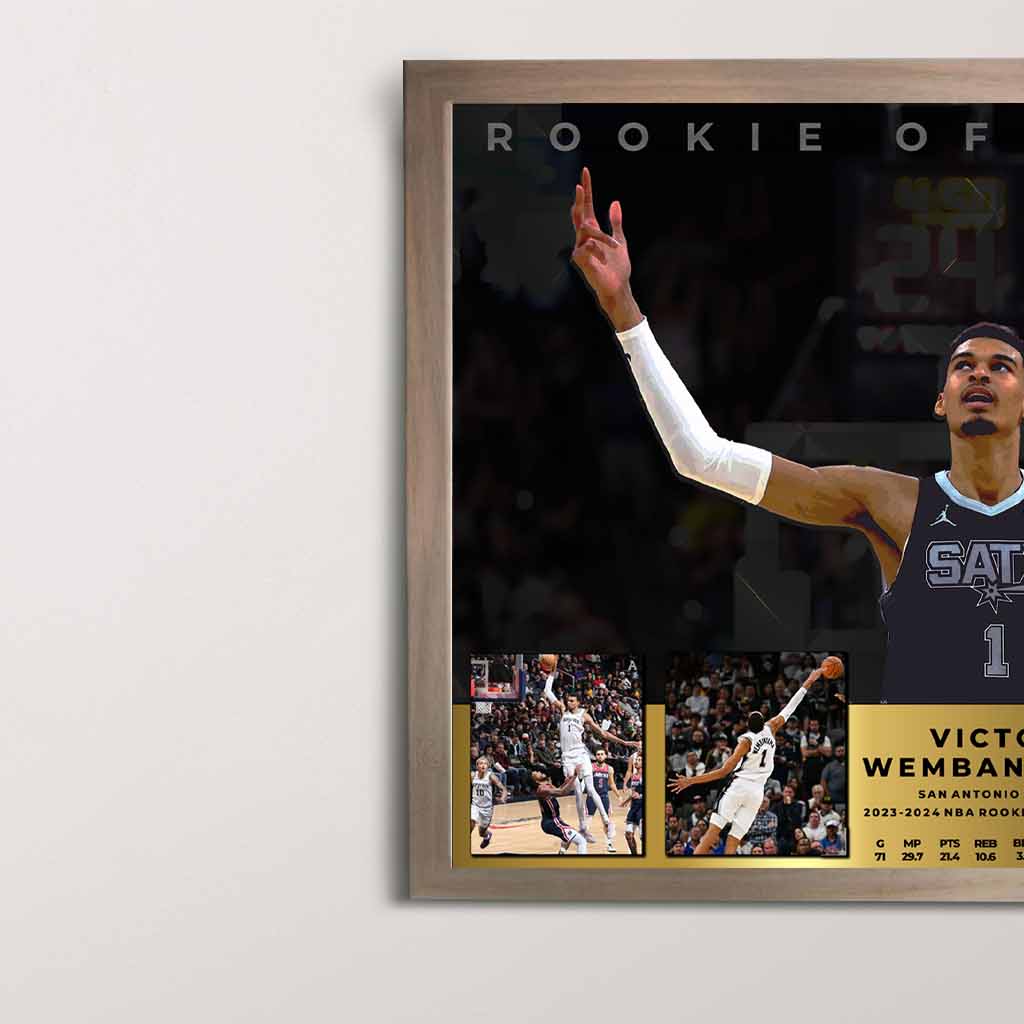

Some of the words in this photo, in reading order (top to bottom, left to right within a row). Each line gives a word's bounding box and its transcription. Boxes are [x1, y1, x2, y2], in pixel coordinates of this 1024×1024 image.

[488, 123, 821, 151] ROOKIE
[897, 123, 987, 151] OF
[983, 623, 1010, 678] 1
[759, 749, 767, 768] 1
[918, 790, 947, 799] SAN
[951, 790, 1019, 799] ANTONIO
[863, 808, 941, 817] 2023-2024
[944, 808, 975, 817] NBA
[876, 839, 885, 848] G
[903, 839, 922, 848] MP
[939, 839, 960, 848] PTS
[974, 839, 997, 848] REB
[875, 852, 886, 861] 71
[901, 852, 923, 861] 29.7
[940, 852, 960, 861] 21.4
[975, 852, 996, 861] 10.6
